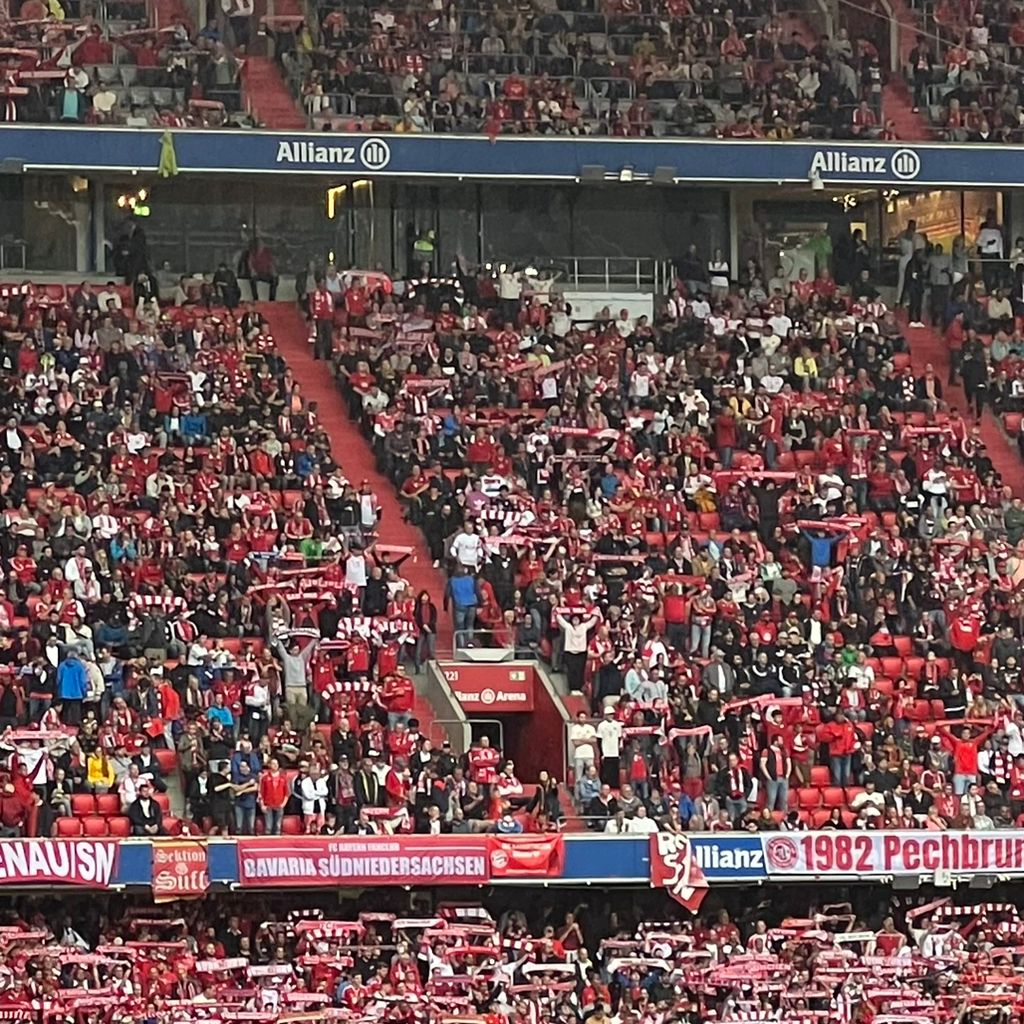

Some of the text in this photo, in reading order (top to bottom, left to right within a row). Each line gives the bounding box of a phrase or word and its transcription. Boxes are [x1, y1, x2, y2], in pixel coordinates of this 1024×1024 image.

[276, 141, 355, 164] Allianz
[811, 151, 887, 173] Allianz
[496, 691, 527, 702] Arena
[695, 844, 764, 870] llianz
[800, 834, 873, 870] 1982
[244, 854, 485, 878] BAVARIA SÜDNIEDERSACHSEN
